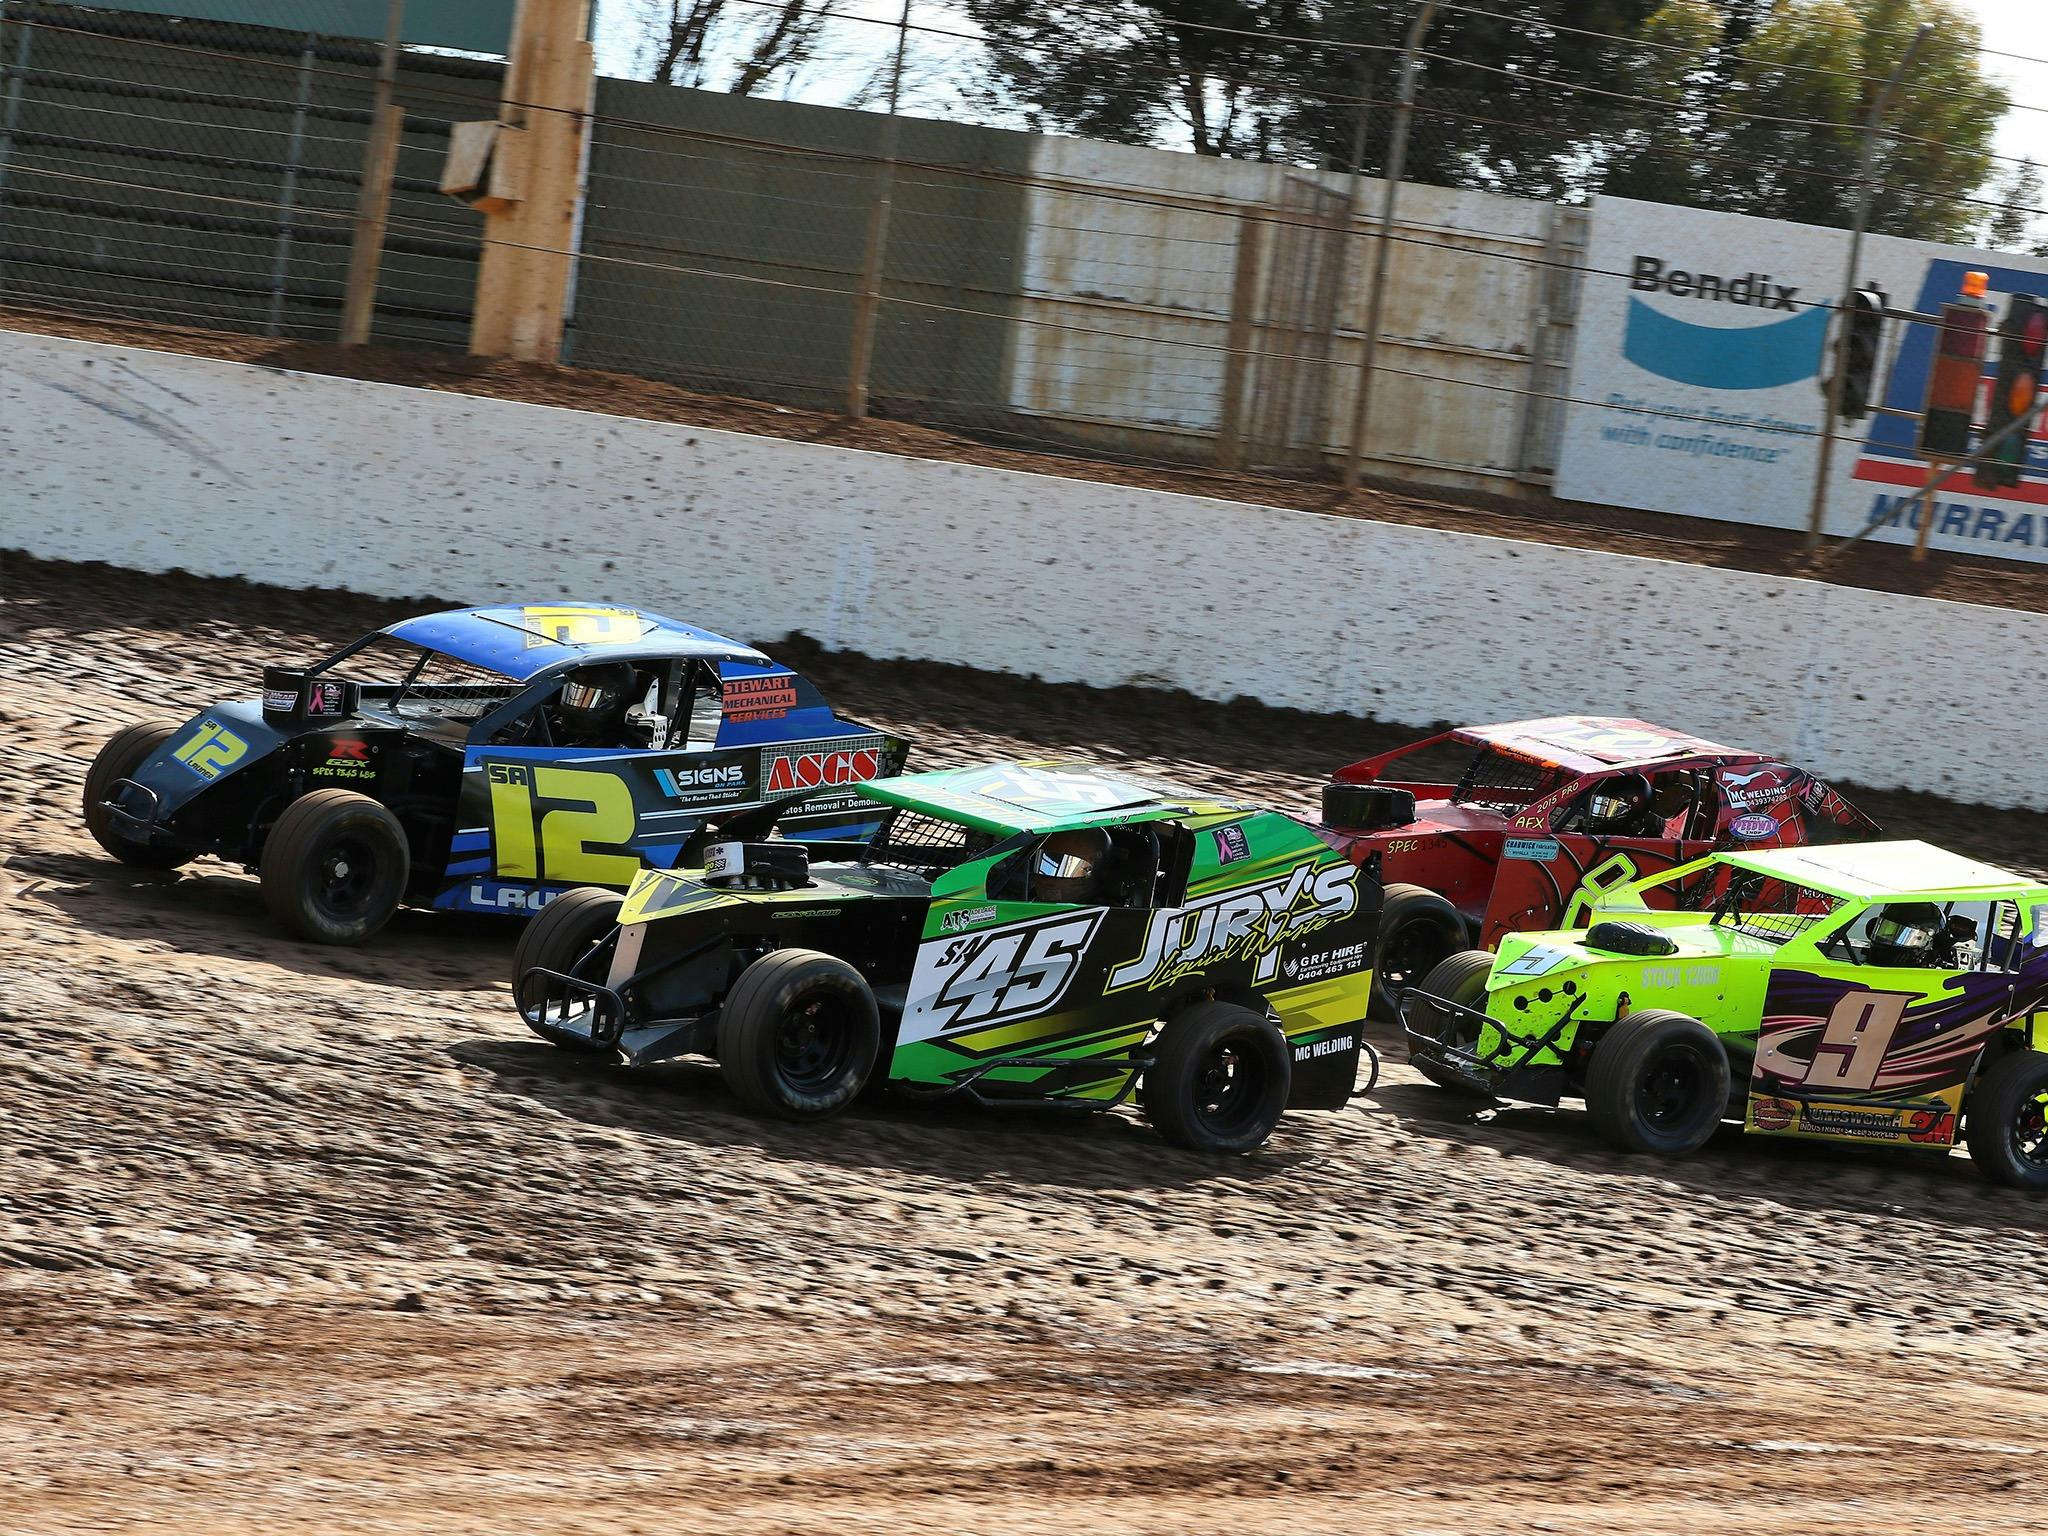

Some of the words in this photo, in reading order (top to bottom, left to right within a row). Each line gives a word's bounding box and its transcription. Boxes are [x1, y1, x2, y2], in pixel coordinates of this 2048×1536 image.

[1630, 255, 1800, 313] Bendix
[1866, 493, 2048, 550] MURRA
[723, 676, 791, 695] STEWART
[724, 693, 794, 709] MECHANICAL
[204, 720, 218, 731] SA
[728, 708, 788, 724] SERVICES
[172, 719, 248, 780] 12
[187, 759, 215, 780] LAUNER
[312, 767, 334, 776] SPEC
[359, 770, 376, 779] LBS
[488, 765, 528, 786] SA
[678, 765, 743, 786] SIGNS
[1536, 795, 1558, 814] 2015
[1561, 782, 1579, 799] PRO
[1731, 789, 1746, 802] MC
[1746, 786, 1787, 799] WELDING
[782, 806, 802, 815] stos
[805, 801, 840, 812] Removal
[488, 763, 641, 886] 12
[1515, 816, 1545, 830] AFX
[1387, 839, 1419, 854] SPEC
[470, 885, 569, 911] LAU
[940, 909, 970, 931] ATS
[1107, 861, 1360, 990] JURY'S
[1331, 943, 1364, 960] HIRE
[940, 914, 1095, 1023] 45
[1148, 937, 1241, 992] Liquid
[1298, 967, 1323, 981] 0404
[1325, 964, 1343, 975] 463
[1346, 959, 1362, 969] 121
[1295, 1046, 1311, 1062] MC
[1313, 1036, 1353, 1058] WELDING
[1801, 990, 1917, 1090] 9
